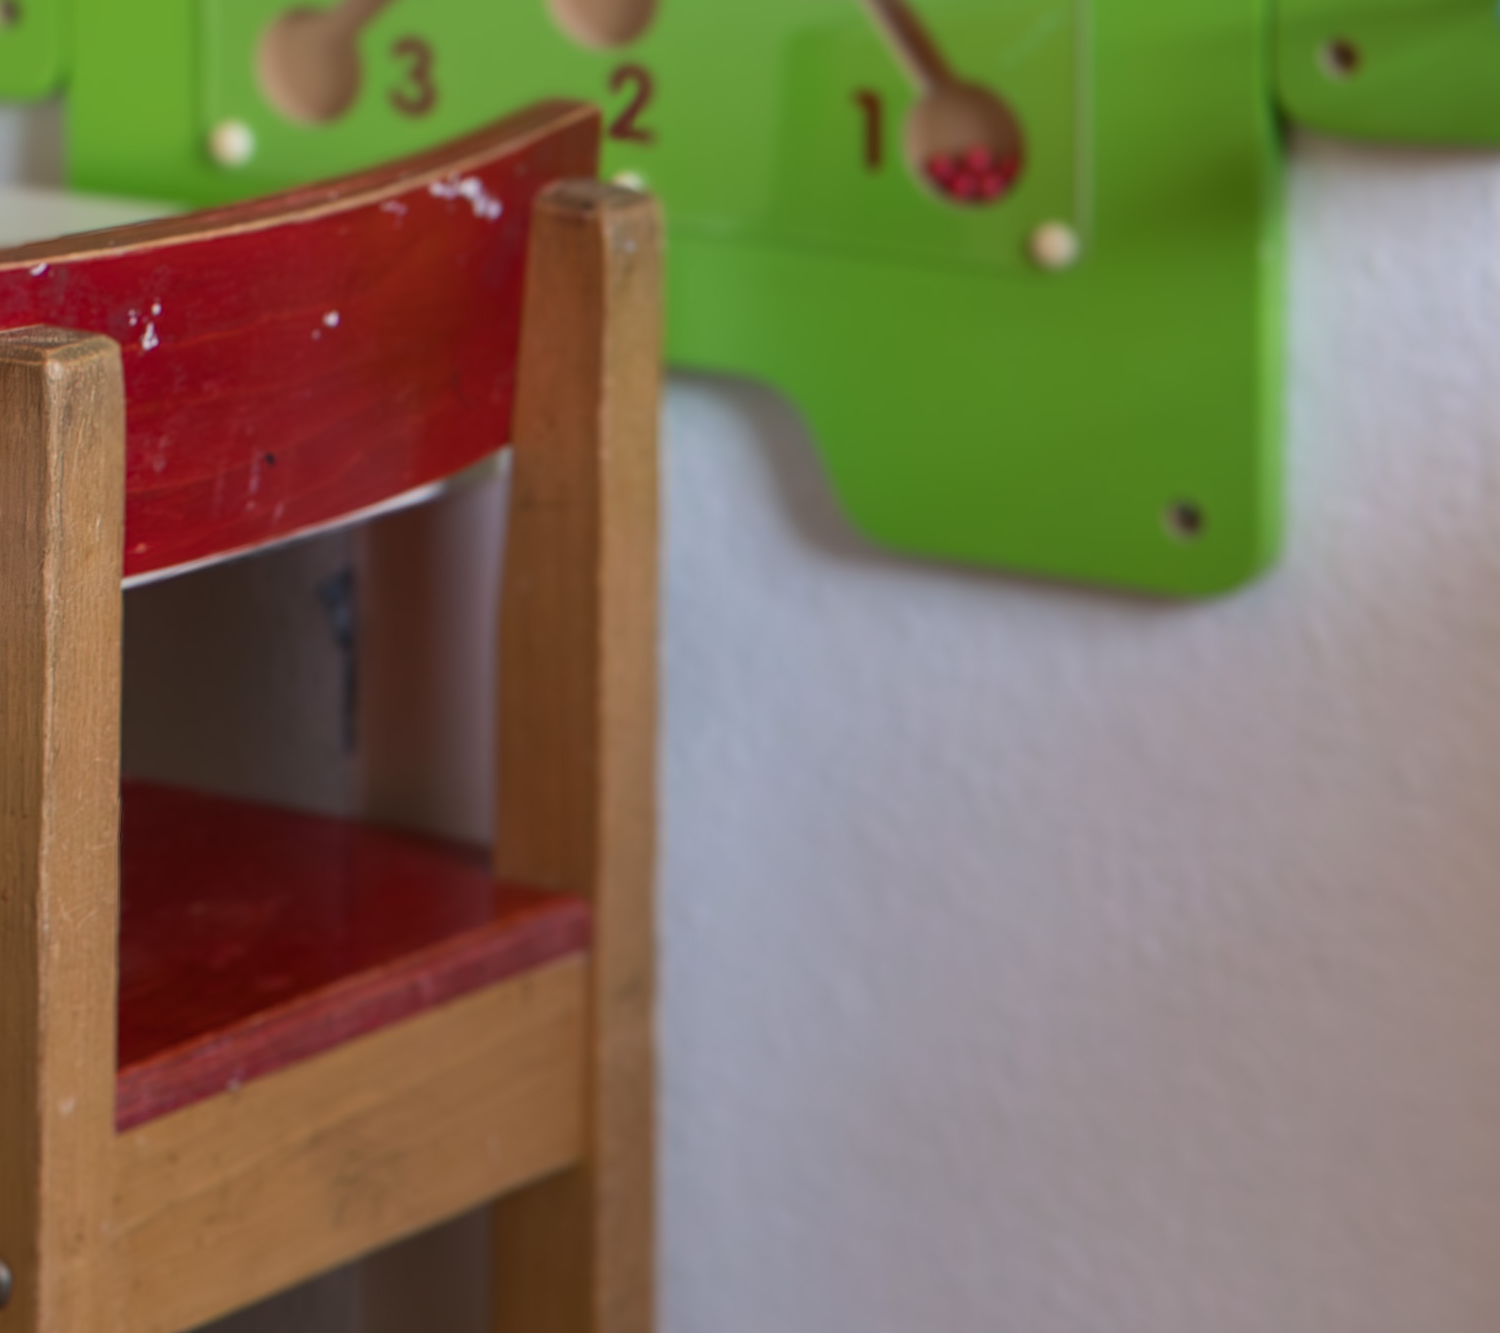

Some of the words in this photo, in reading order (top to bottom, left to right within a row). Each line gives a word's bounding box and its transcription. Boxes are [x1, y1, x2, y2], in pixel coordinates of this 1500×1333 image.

[387, 36, 437, 117] 3
[607, 62, 655, 144] 2
[852, 87, 884, 171] 1
